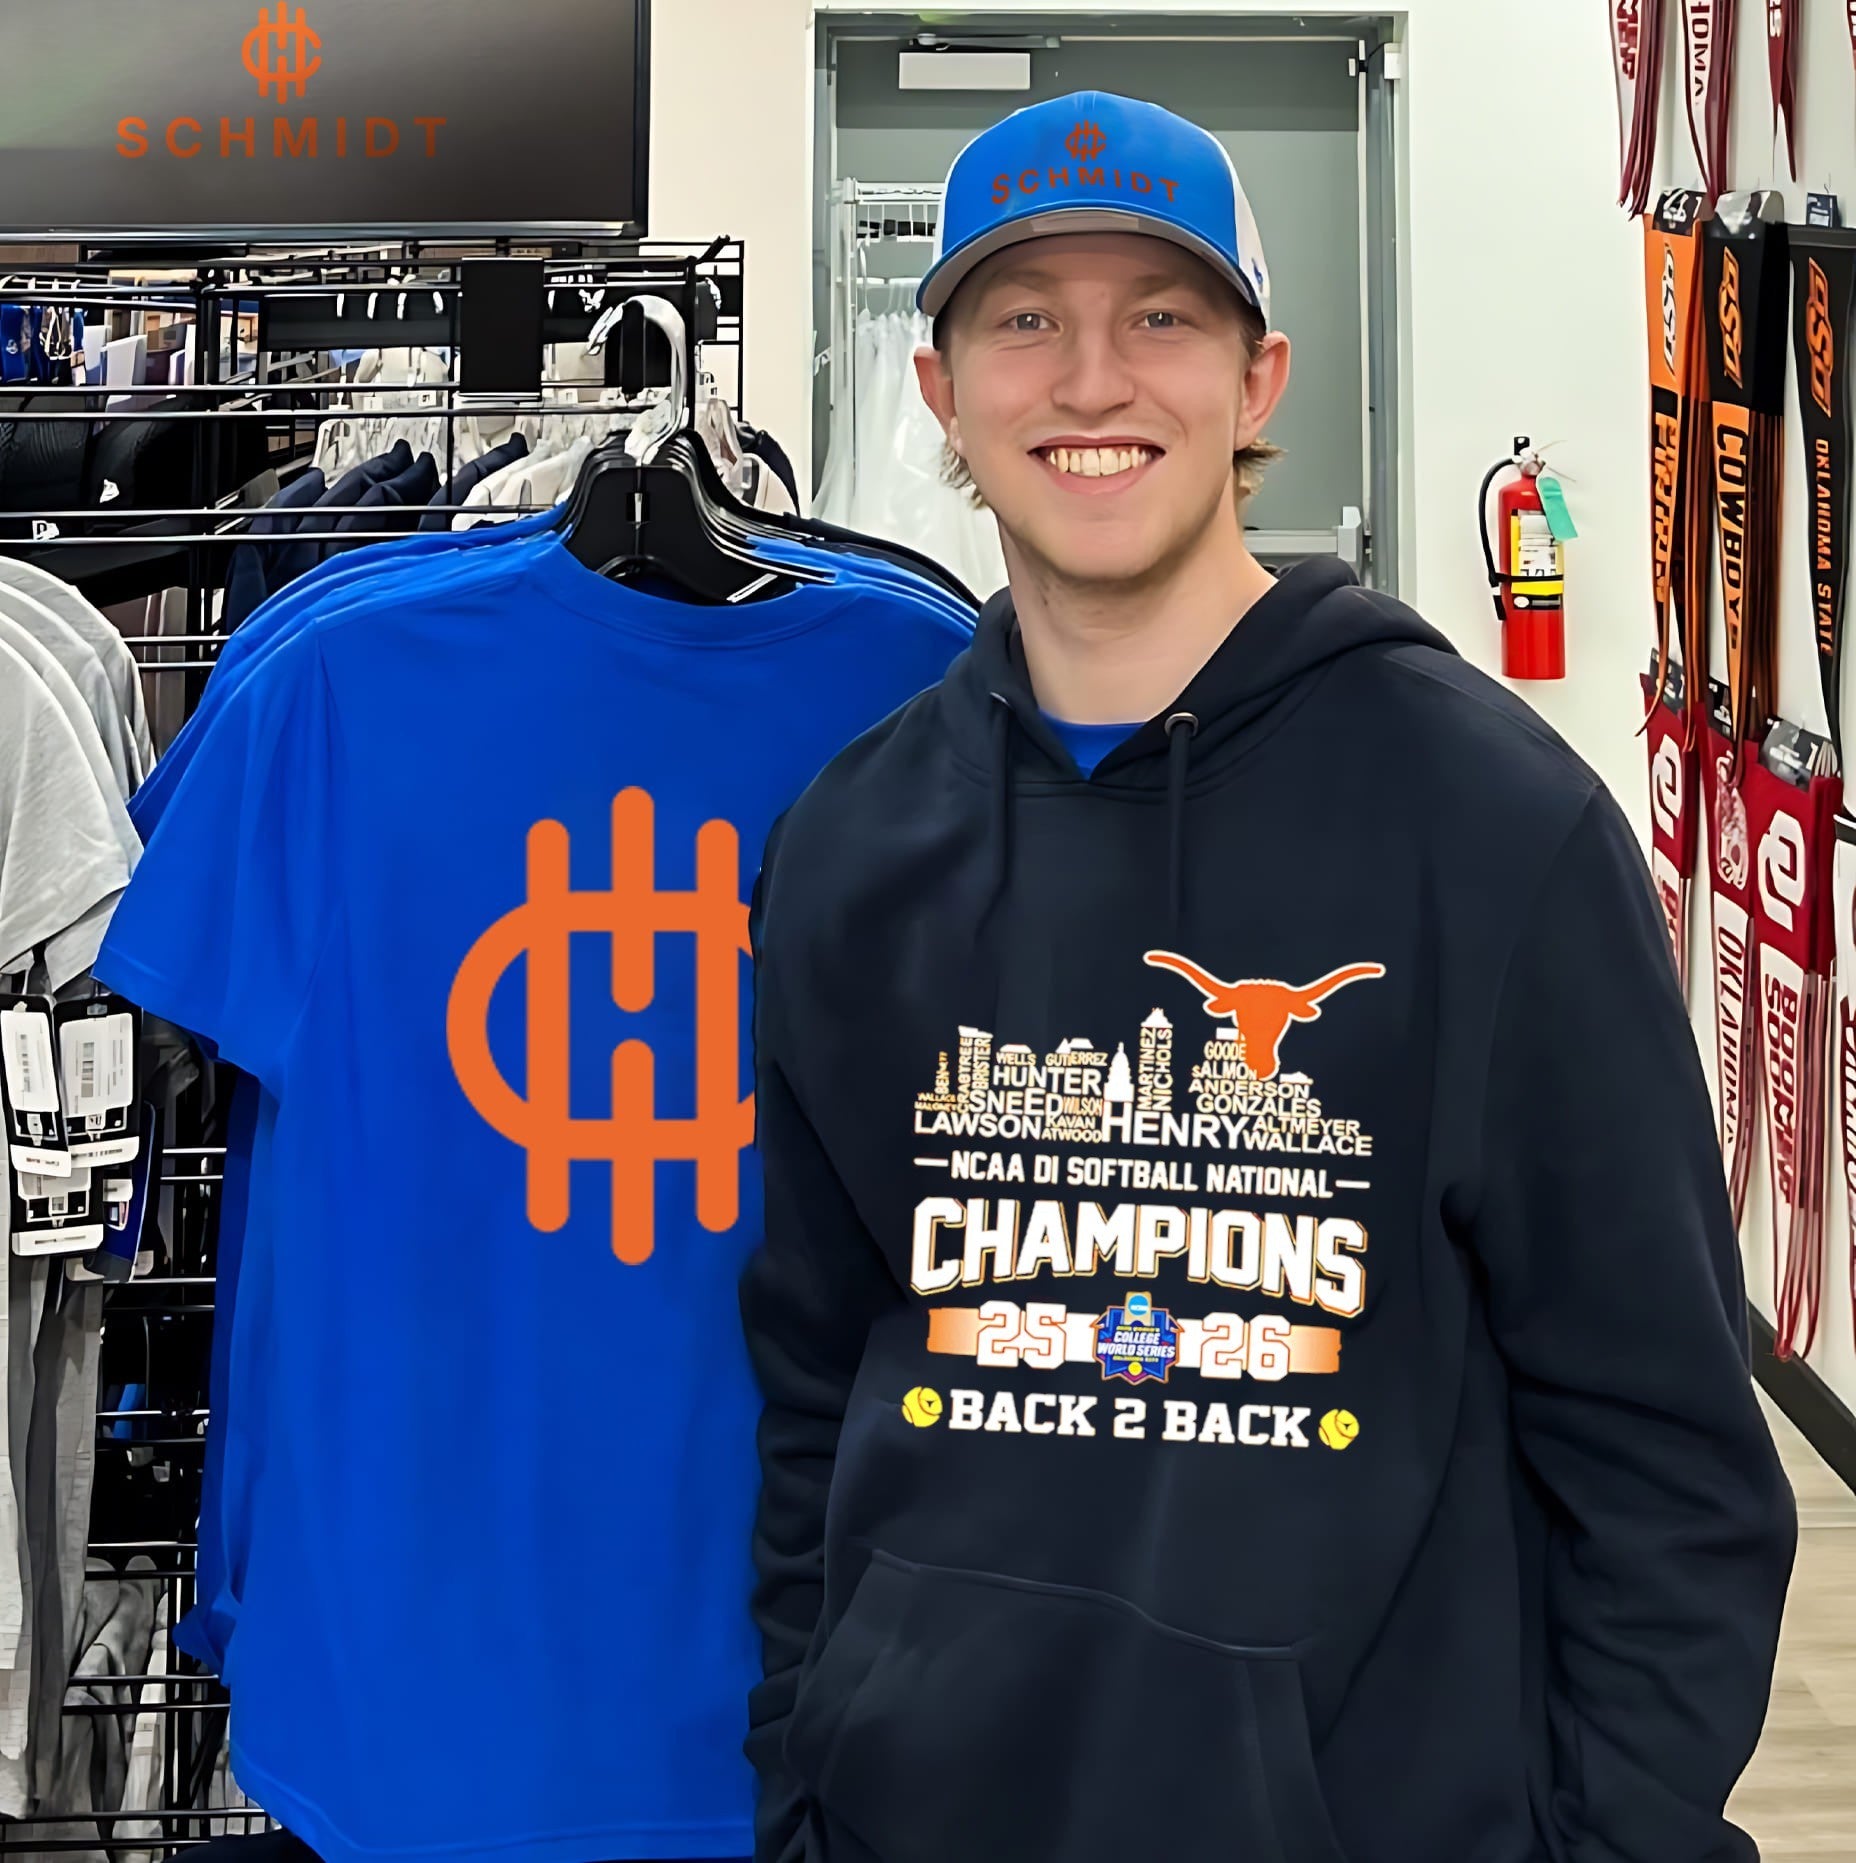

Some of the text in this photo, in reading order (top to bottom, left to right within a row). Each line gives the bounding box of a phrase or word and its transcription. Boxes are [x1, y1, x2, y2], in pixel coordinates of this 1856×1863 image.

[115, 116, 448, 158] SCHMIDT
[991, 166, 1180, 204] SCHMIDT
[971, 1038, 992, 1090] BRISTER
[996, 1052, 1037, 1066] WELLS
[1045, 1051, 1109, 1067] GUTIERREZ
[1204, 1041, 1247, 1062] GOODE
[956, 1037, 973, 1114] CRABTREE
[993, 1065, 1102, 1096] HUNTER
[1137, 1027, 1156, 1111] MARTINEZ
[1151, 1028, 1173, 1112] NICHOLS
[1191, 1060, 1257, 1081] SALMON
[969, 1087, 1064, 1118] SNEED
[1188, 1078, 1310, 1099] ANDERSON
[1196, 1093, 1322, 1118] GONZALES
[914, 1110, 1041, 1140] LAWSON
[1041, 1128, 1102, 1143] ATWOOD
[1045, 1113, 1096, 1130] KAVAN
[1101, 1101, 1250, 1149] HENRY
[1252, 1115, 1361, 1137] ALTMEYER
[1242, 1130, 1373, 1156] WALLACE
[951, 1150, 1333, 1198] NCAA DI SOFTBALL NATIONAL
[911, 1197, 1367, 1317] CHAMPIONS
[977, 1300, 1067, 1369] 25
[1097, 1342, 1176, 1358] WORLD SERIES
[1113, 1331, 1160, 1345] COLLEGE
[1200, 1312, 1292, 1381] 26
[949, 1389, 1310, 1447] BACK 2 BACK
